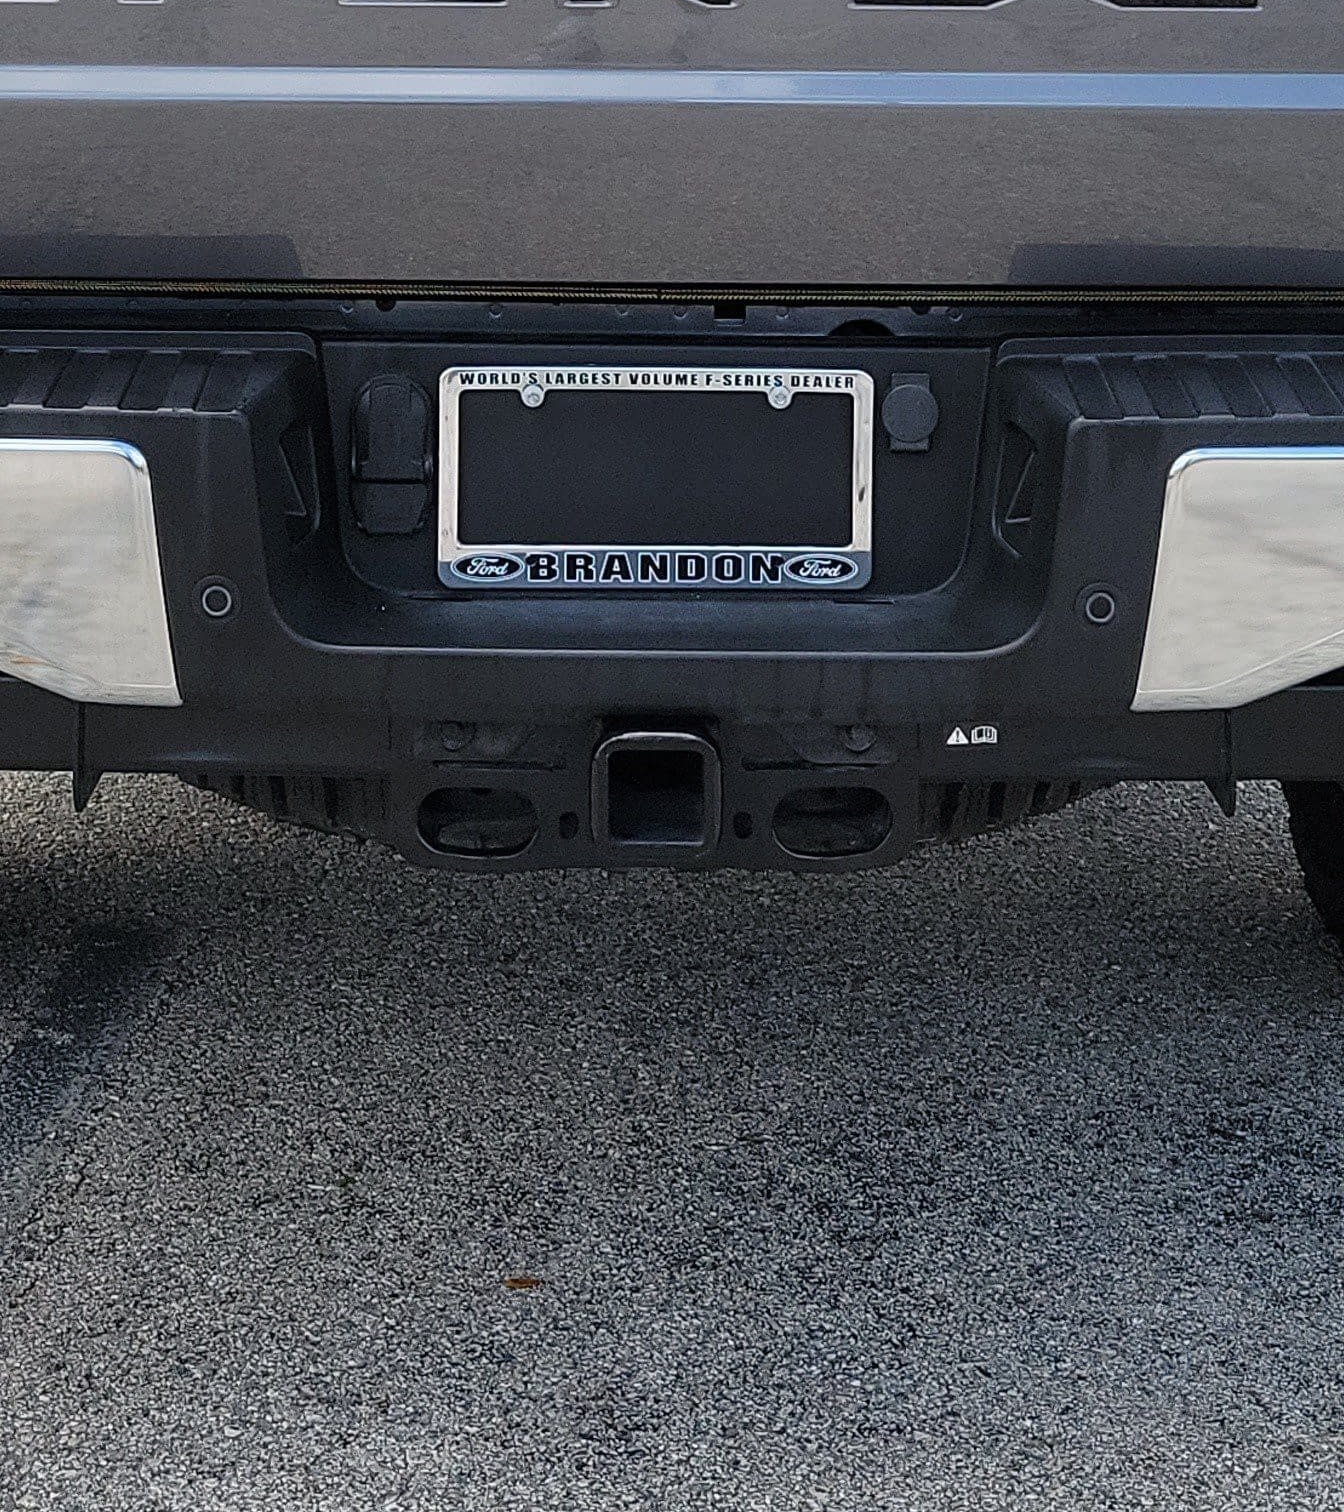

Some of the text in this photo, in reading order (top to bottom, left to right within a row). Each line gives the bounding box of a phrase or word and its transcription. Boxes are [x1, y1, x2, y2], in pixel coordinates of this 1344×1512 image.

[459, 372, 854, 388] WORLD'S LARGEST VOLUME F-SERIES DEALER
[467, 552, 841, 584] Ford BRANDON Ford
